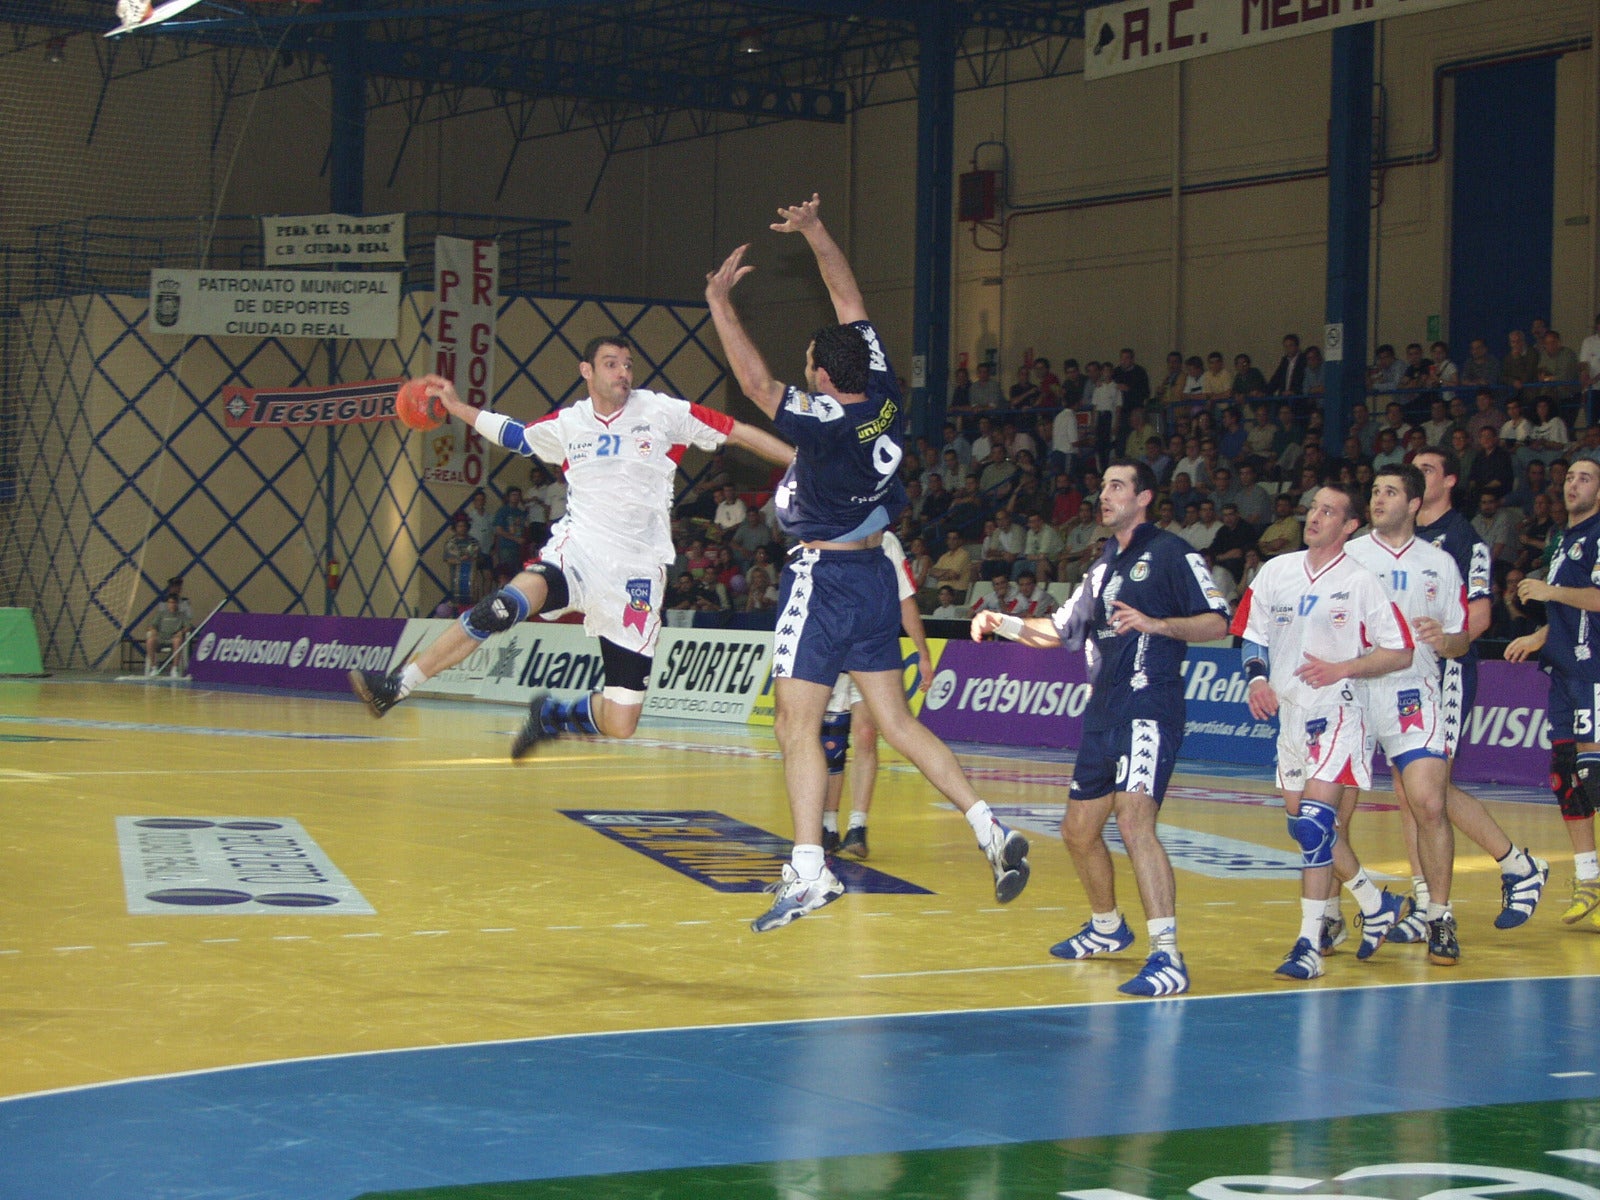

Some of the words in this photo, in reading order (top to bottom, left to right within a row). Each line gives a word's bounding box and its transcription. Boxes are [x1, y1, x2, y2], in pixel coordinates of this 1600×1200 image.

[1122, 9, 1207, 61] A.C.
[304, 242, 352, 255] CIUDAD
[357, 241, 390, 253] REAL
[198, 278, 295, 293] PATRONATO
[300, 279, 388, 294] MUNICIPAL
[234, 299, 256, 314] DE
[262, 299, 350, 315] DEPORTES
[225, 321, 297, 335] CIUDAD
[302, 322, 350, 336] REAL
[596, 434, 621, 457] 21
[872, 434, 903, 491] 9
[1391, 570, 1408, 591] 11
[1298, 595, 1319, 617] 17
[658, 640, 765, 695] SPORTEC
